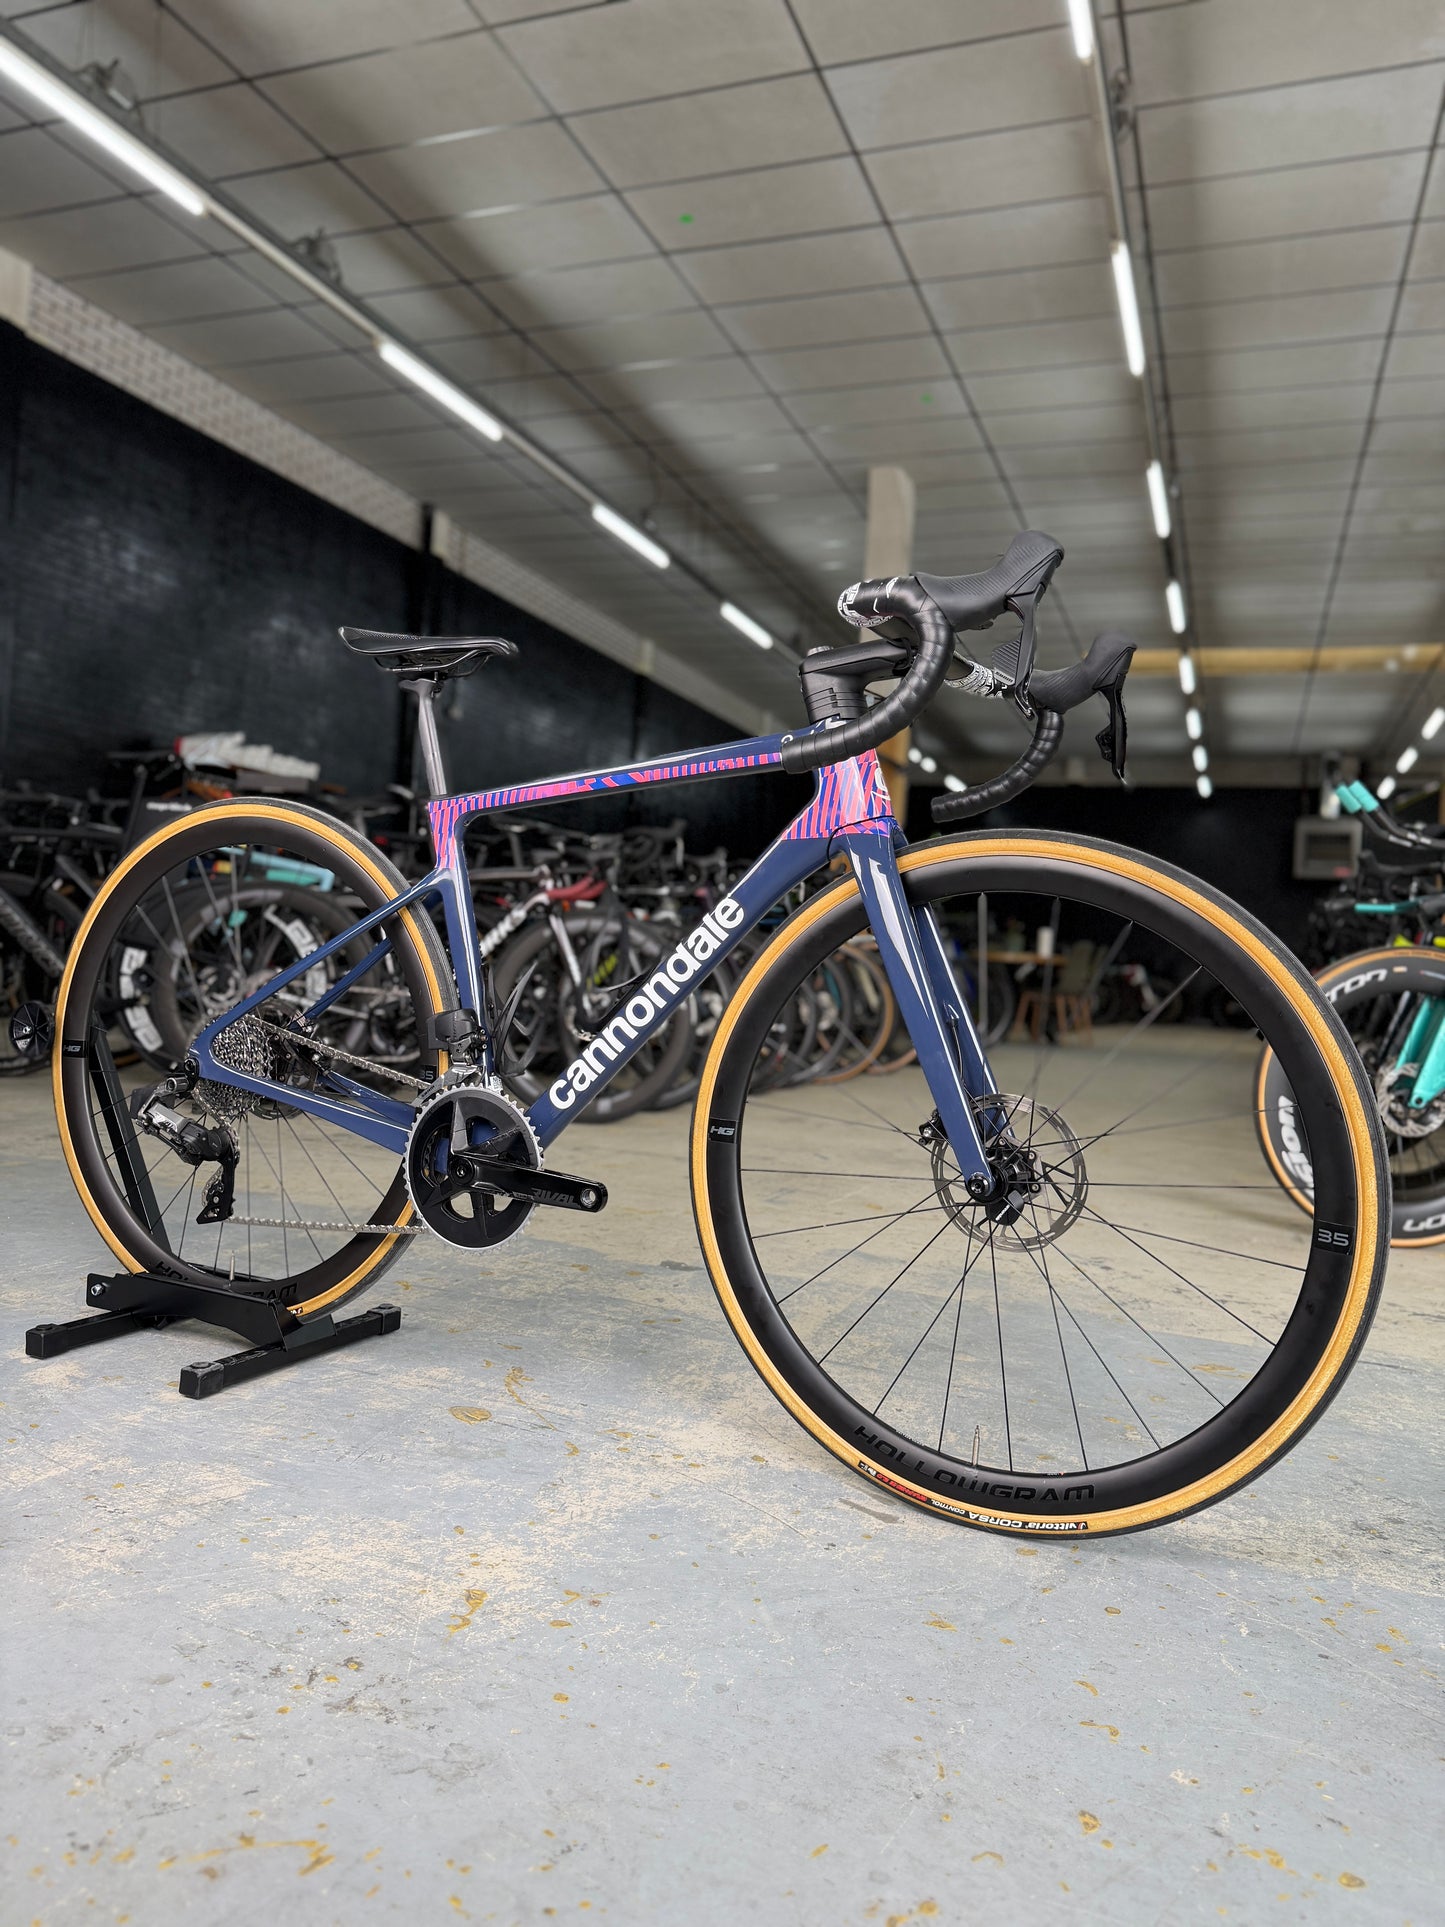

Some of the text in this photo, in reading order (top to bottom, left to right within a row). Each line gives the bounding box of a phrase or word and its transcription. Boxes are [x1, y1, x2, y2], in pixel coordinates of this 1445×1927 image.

[549, 896, 745, 1110] cannondale
[710, 1125, 735, 1136] HG
[531, 1187, 580, 1207] RIVAL
[1318, 1228, 1350, 1248] 35
[853, 1425, 1095, 1502] HOLLOWGRAM
[930, 1498, 1077, 1531] vittoria CORSA CONTROL
